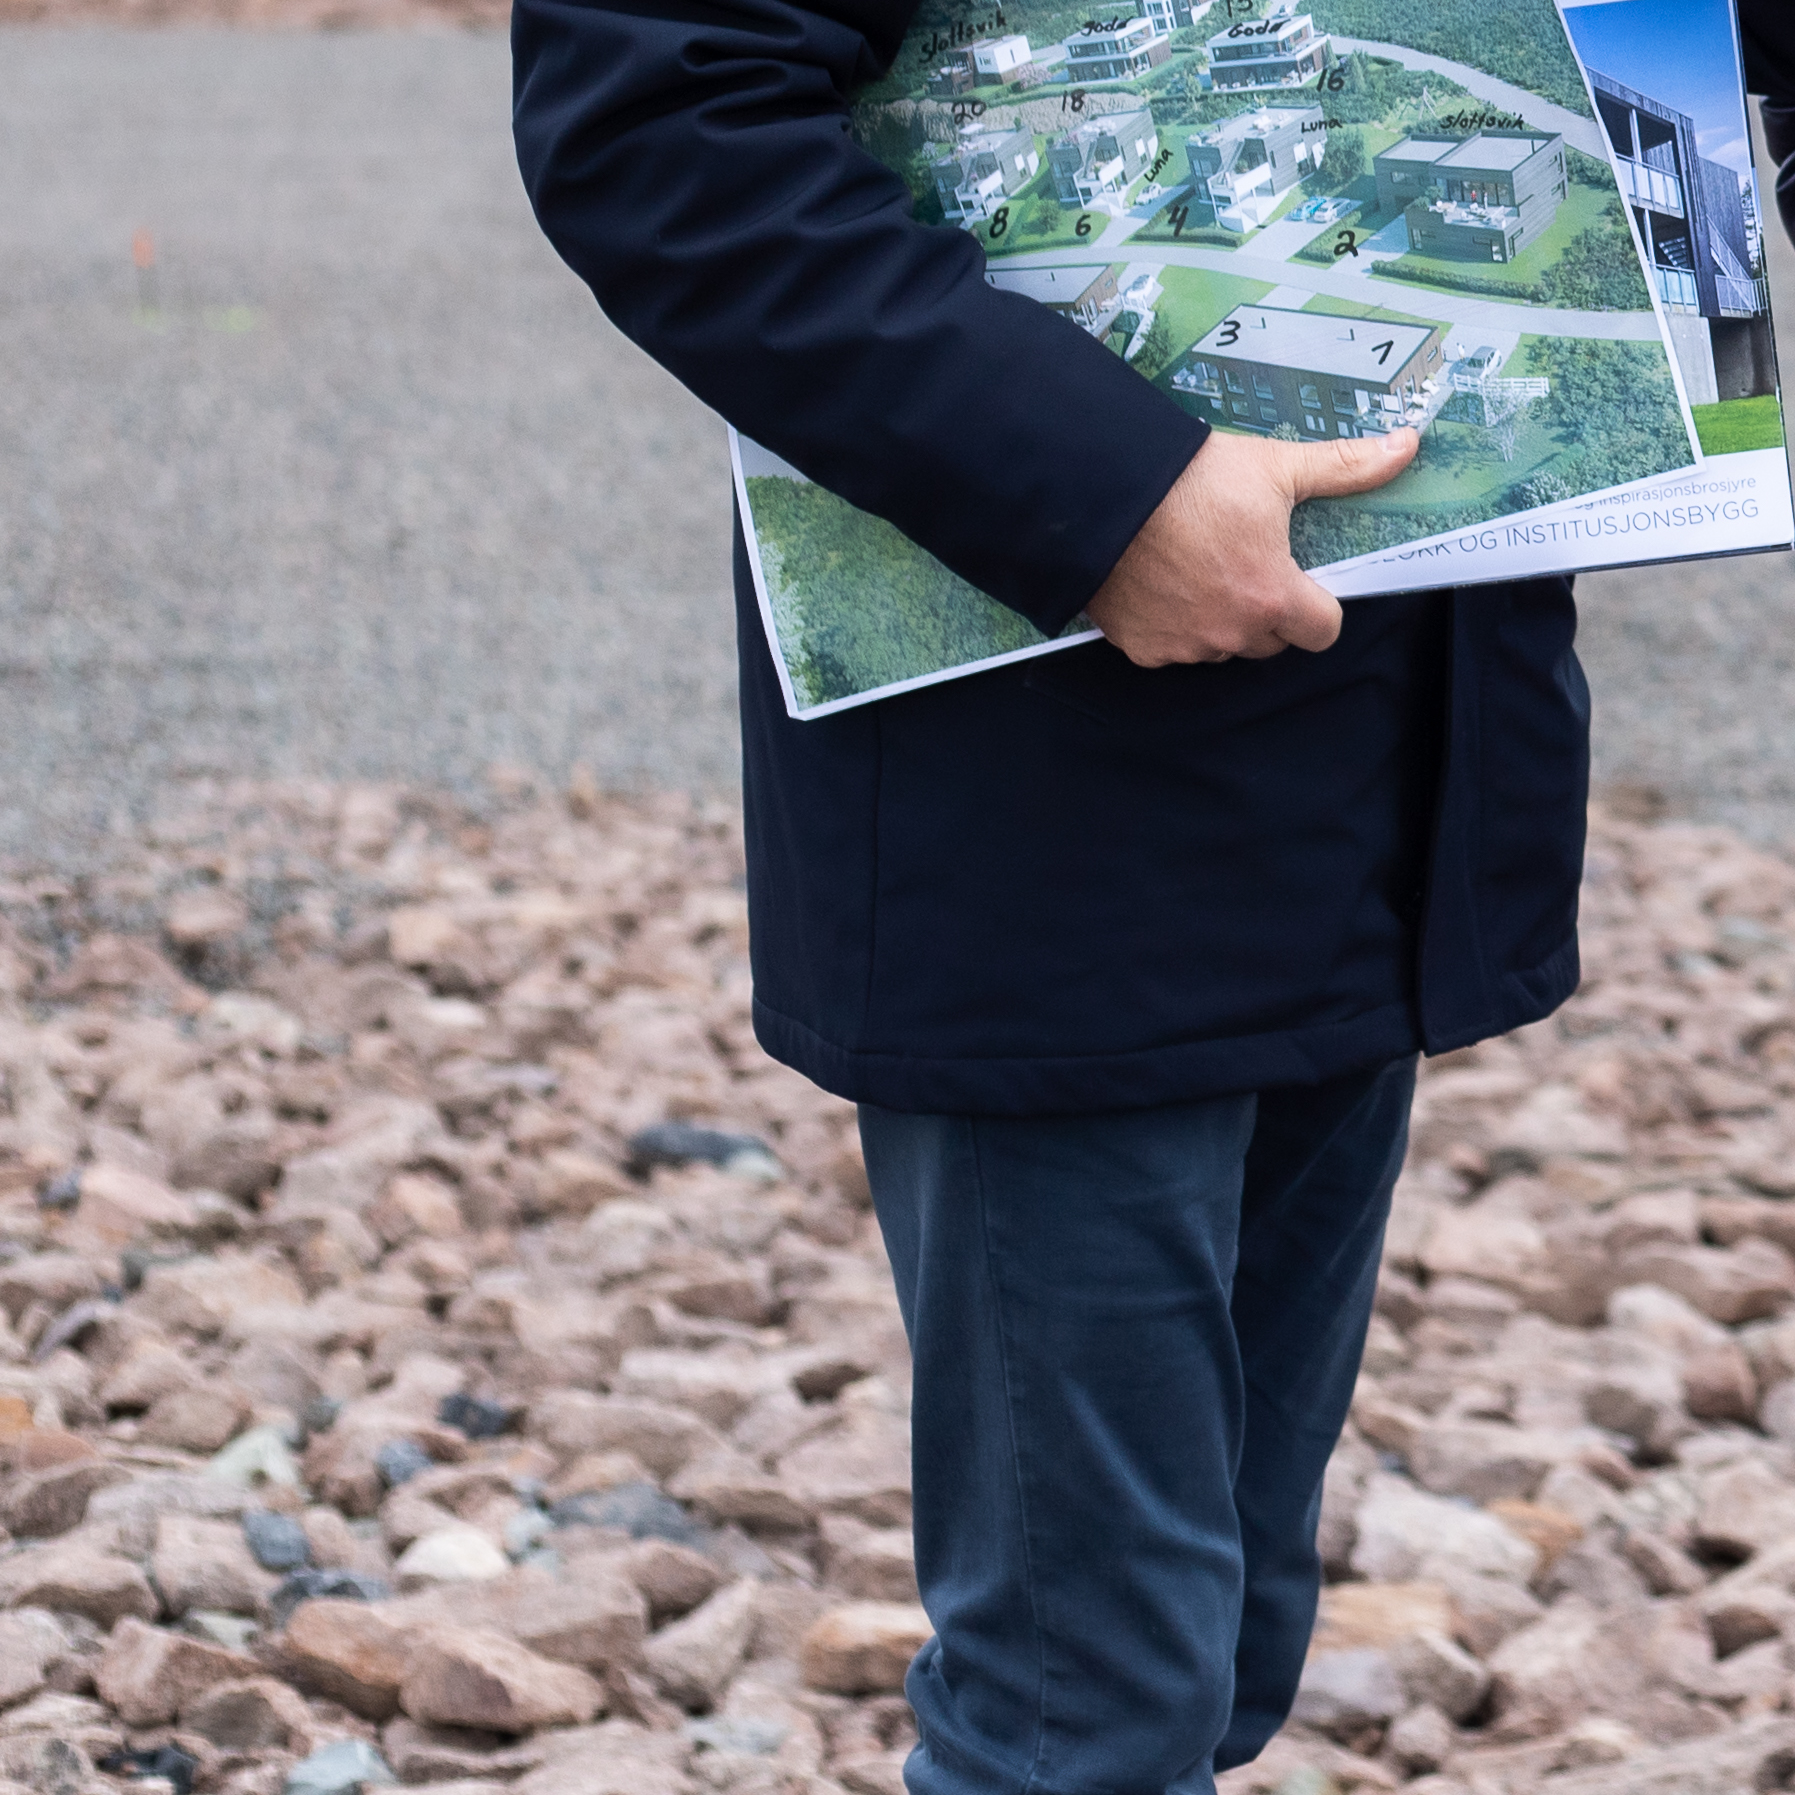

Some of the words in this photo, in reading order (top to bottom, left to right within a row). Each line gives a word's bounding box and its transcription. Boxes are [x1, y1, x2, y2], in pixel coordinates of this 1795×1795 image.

[1316, 66, 1346, 92] 16
[950, 95, 987, 125] 20
[1061, 88, 1086, 112] 18
[988, 205, 1010, 239] 8
[1074, 214, 1092, 237] 6
[1167, 204, 1190, 237] 4
[1333, 229, 1360, 258] 2
[1215, 319, 1242, 347] 3
[1371, 339, 1395, 366] 1
[1458, 530, 1498, 553] OG
[1506, 498, 1759, 548] INSTITUSJONSBYGG
